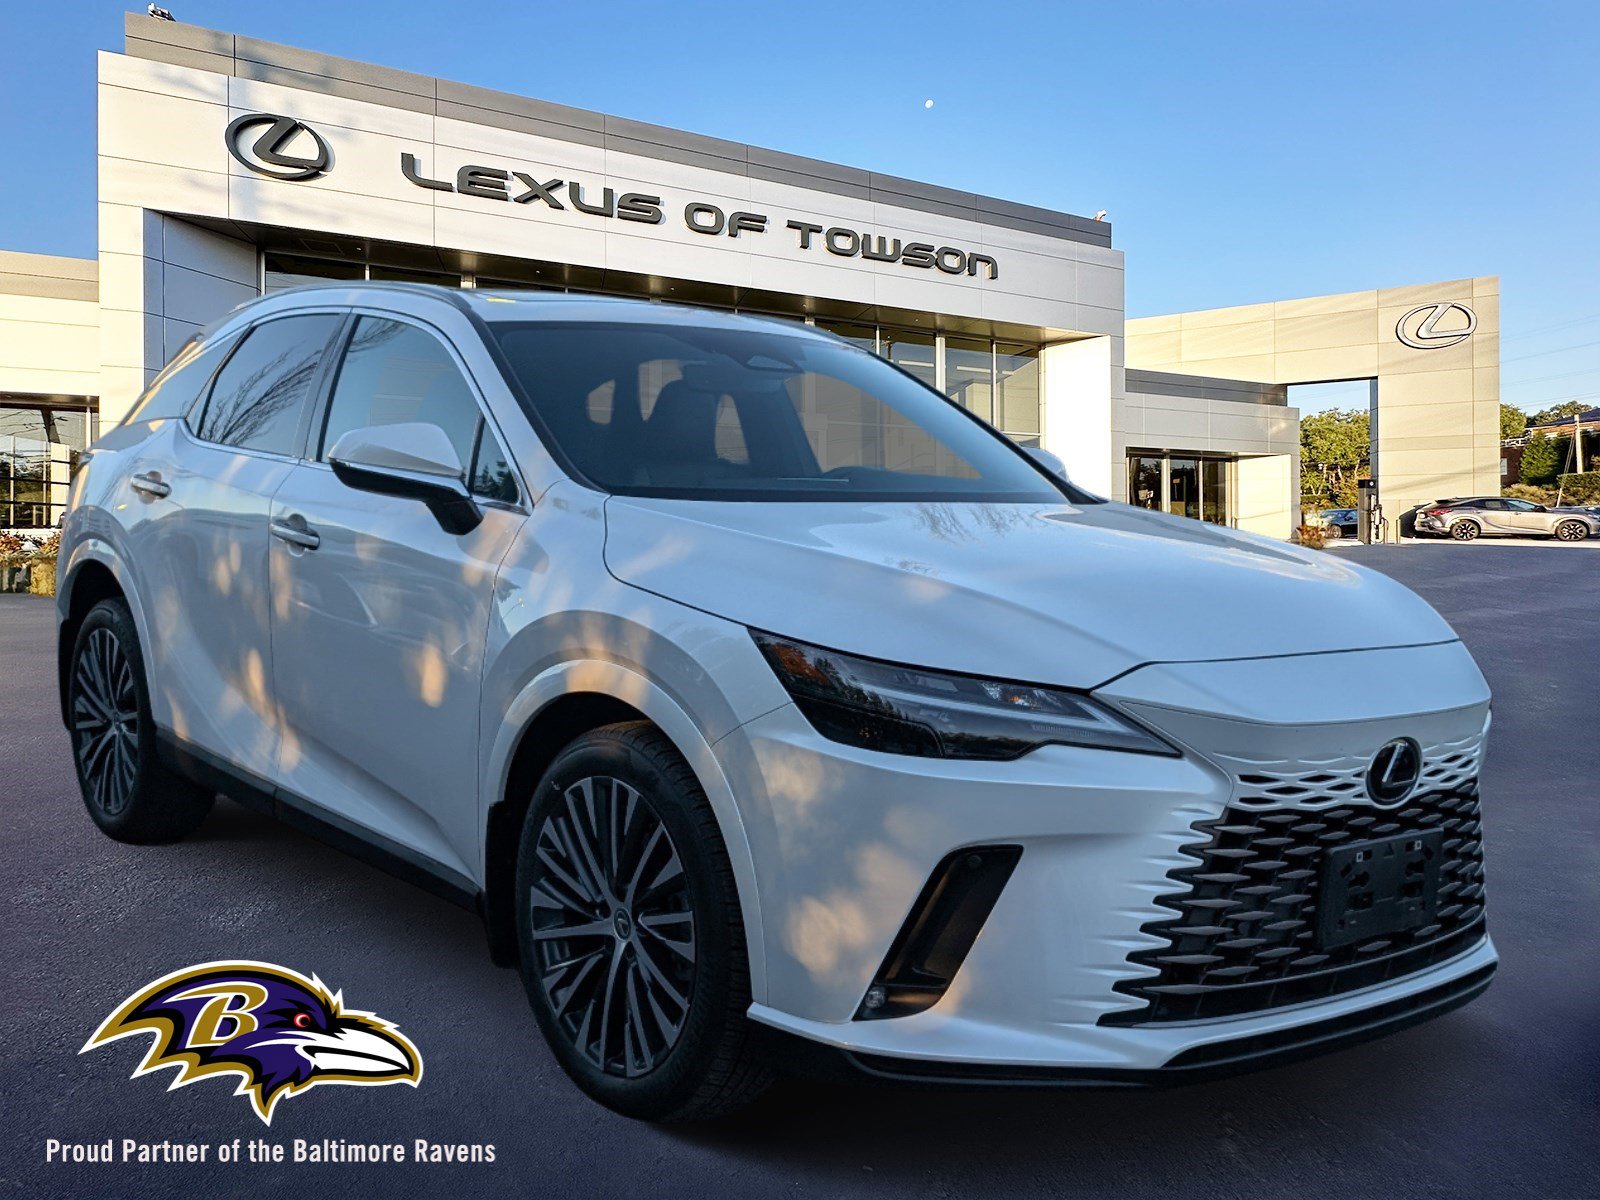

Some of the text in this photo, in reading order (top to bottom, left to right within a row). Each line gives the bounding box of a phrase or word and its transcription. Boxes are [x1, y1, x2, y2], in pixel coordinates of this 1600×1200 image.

[401, 152, 999, 280] LEXUS OF TOWSON
